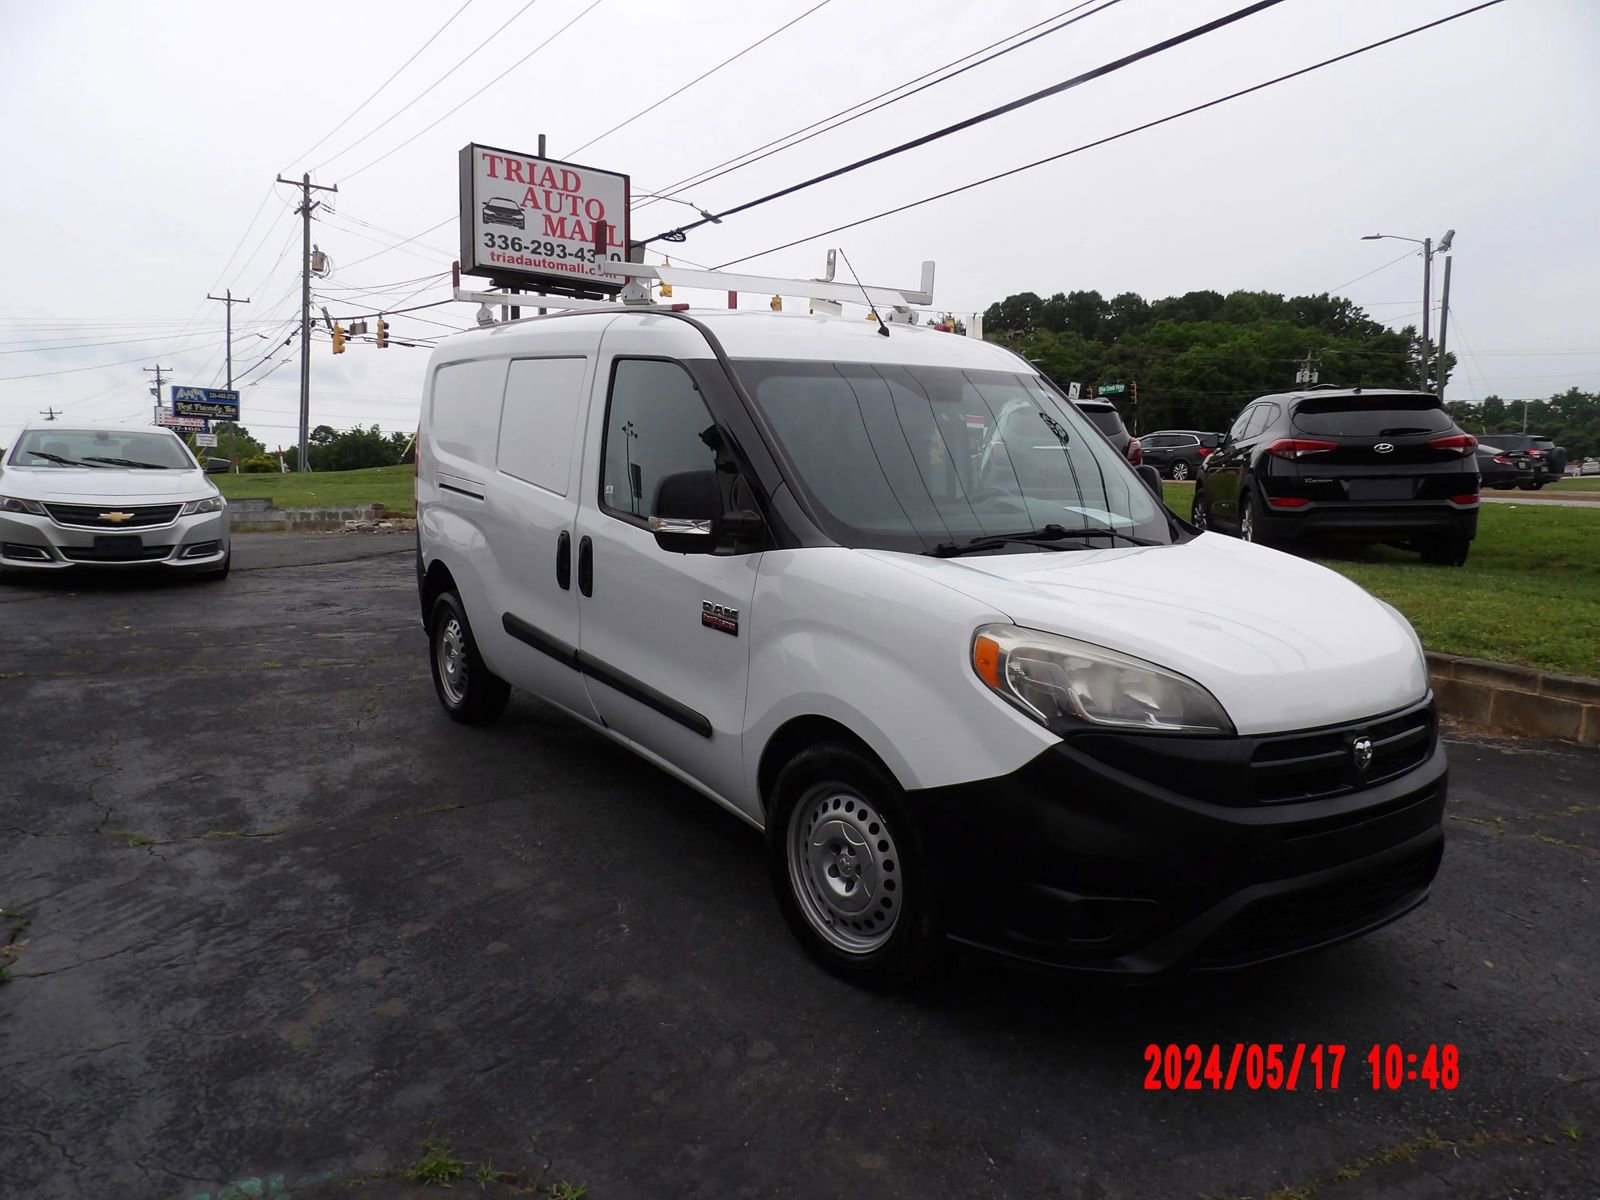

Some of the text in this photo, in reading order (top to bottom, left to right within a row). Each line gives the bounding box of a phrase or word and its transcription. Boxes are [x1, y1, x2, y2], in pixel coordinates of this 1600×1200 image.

[482, 152, 581, 193] TRIAD
[520, 187, 605, 221] AUTO
[483, 232, 622, 263] 336-293-430
[490, 251, 617, 278] triadautomall.c
